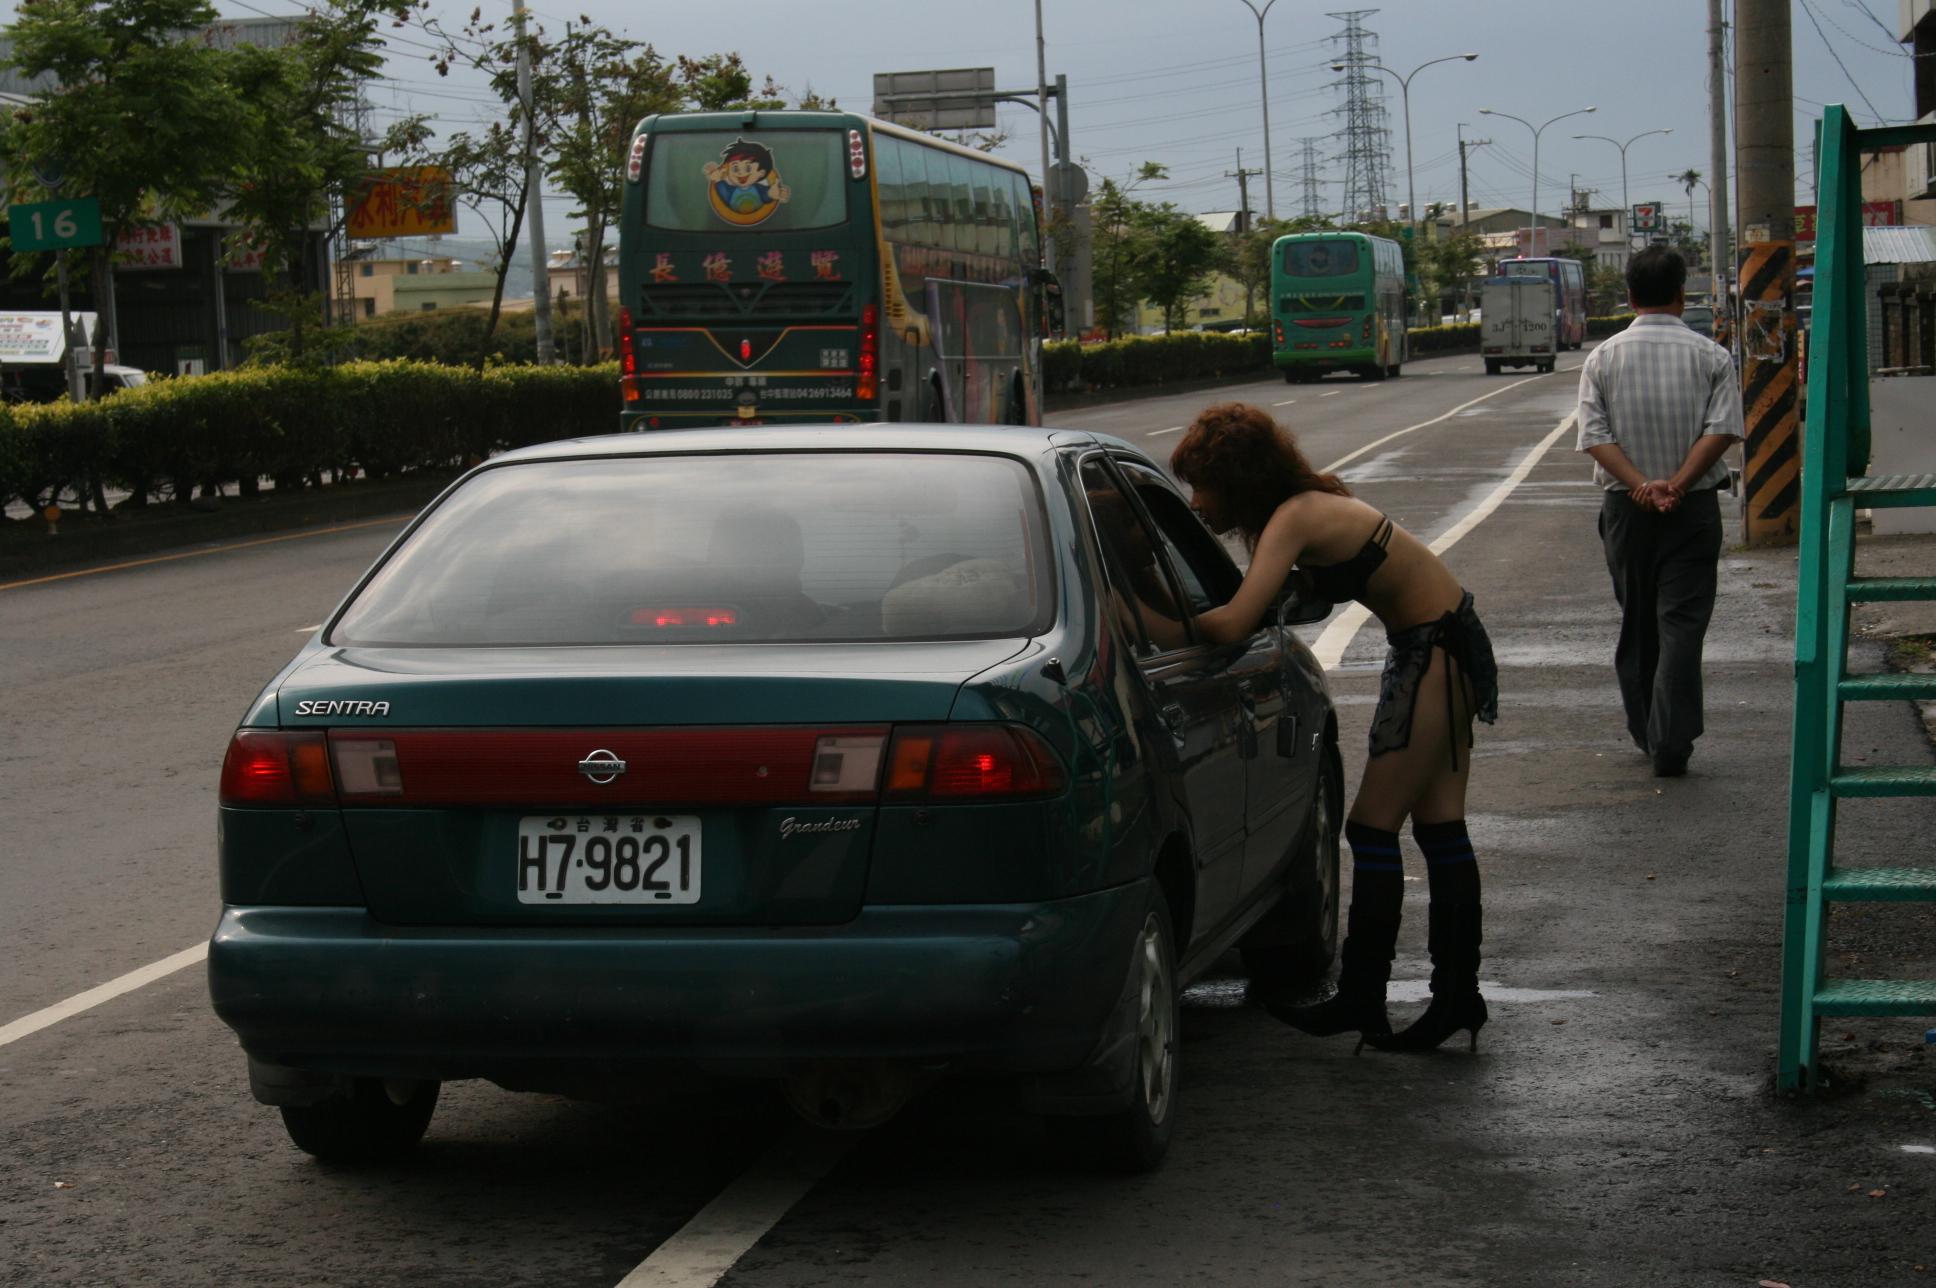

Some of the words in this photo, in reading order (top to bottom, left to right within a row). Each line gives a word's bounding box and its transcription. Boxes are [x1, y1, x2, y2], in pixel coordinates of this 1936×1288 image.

[31, 209, 78, 241] 16
[295, 700, 390, 716] SENTRA
[581, 763, 623, 772] NISSAN
[576, 816, 645, 833] 台灣省
[778, 816, 862, 840] Grandeur
